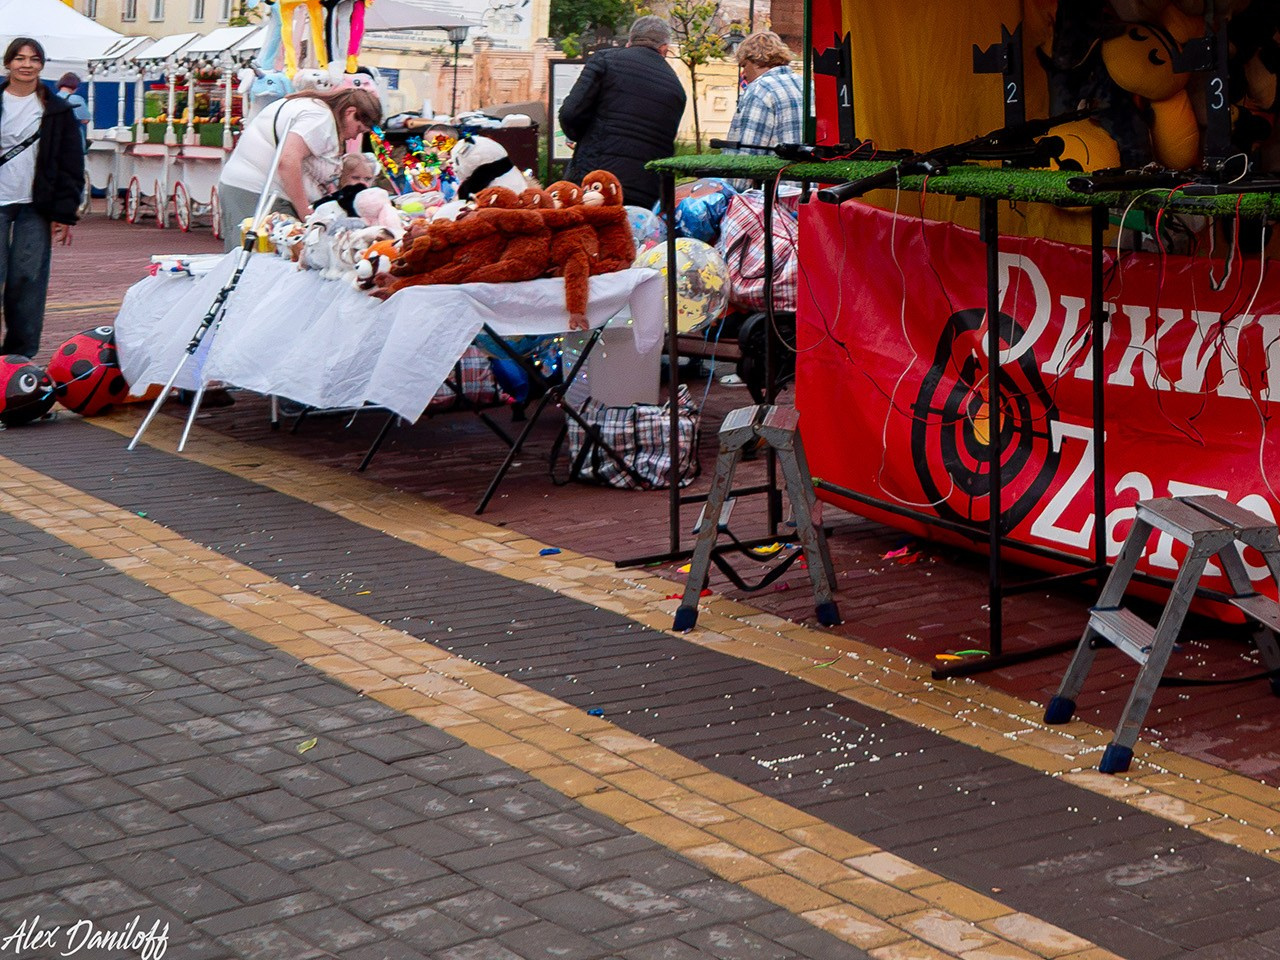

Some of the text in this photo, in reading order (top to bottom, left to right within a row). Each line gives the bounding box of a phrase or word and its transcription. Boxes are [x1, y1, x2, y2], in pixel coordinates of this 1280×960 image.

[839, 84, 851, 107] 1
[1006, 82, 1018, 104] 2
[1210, 77, 1224, 110] 3
